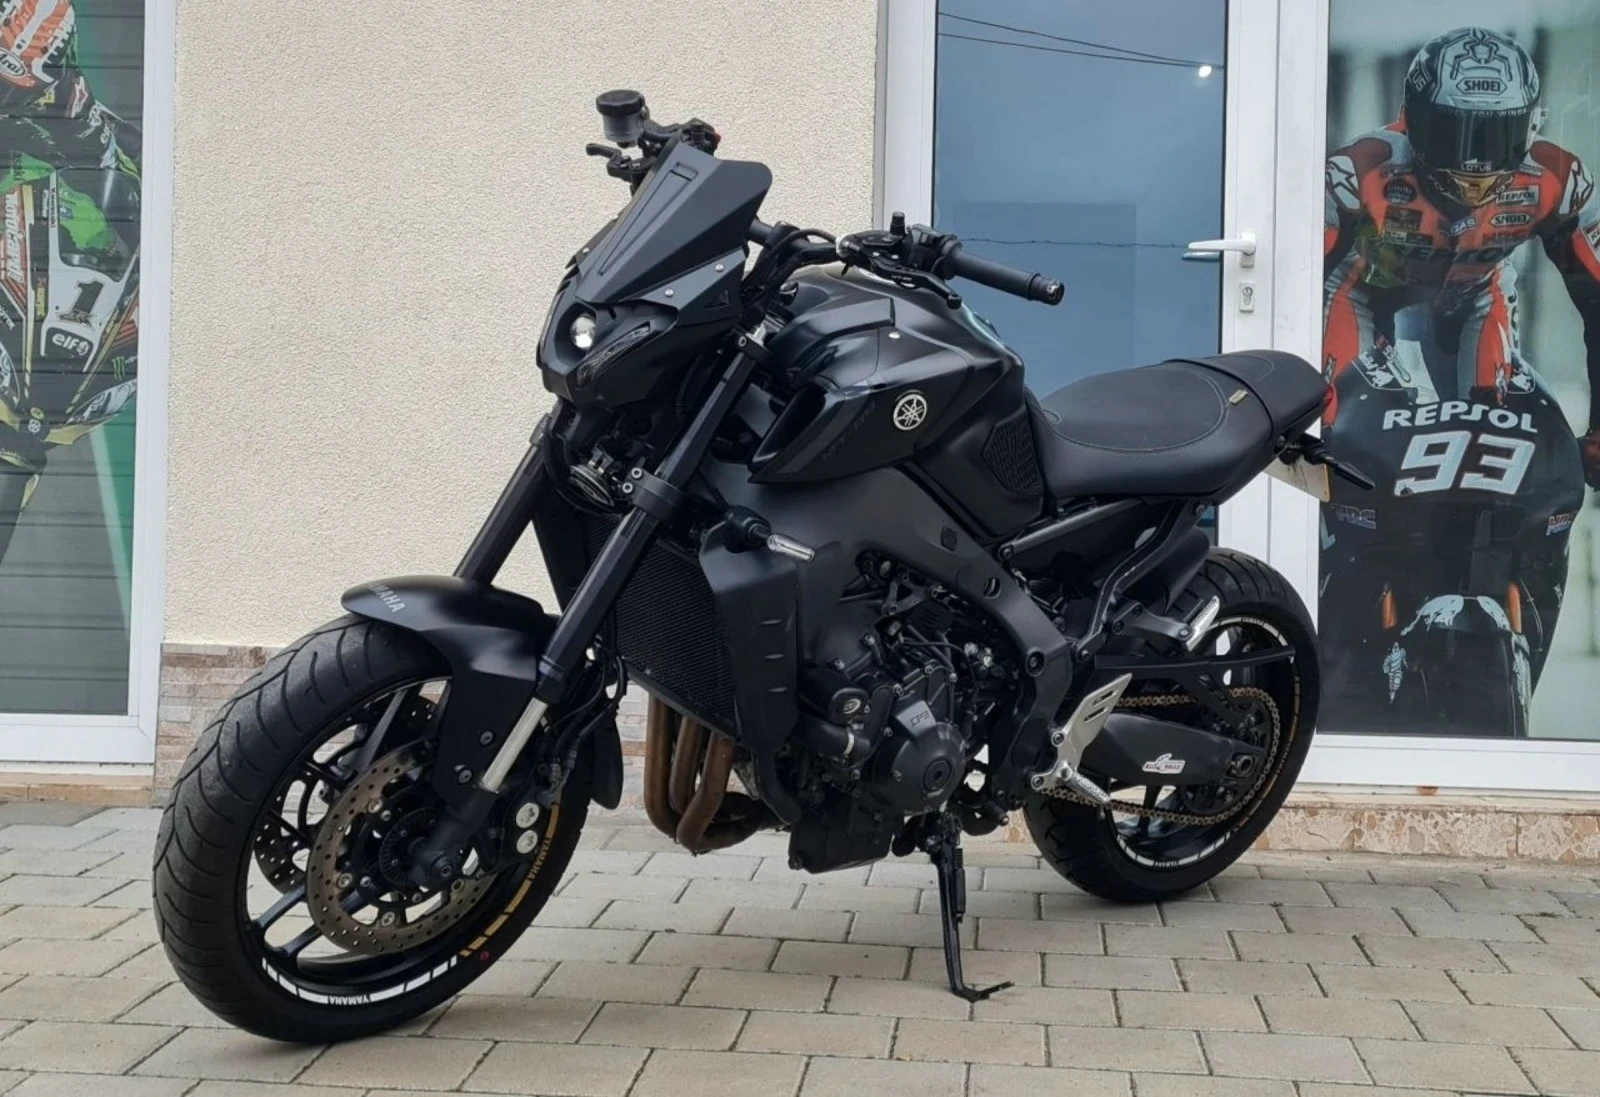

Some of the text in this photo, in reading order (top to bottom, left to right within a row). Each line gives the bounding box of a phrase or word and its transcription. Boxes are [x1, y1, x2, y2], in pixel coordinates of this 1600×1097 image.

[1463, 80, 1501, 92] SHOEI
[72, 280, 104, 314] 1
[52, 332, 80, 351] elf
[1382, 400, 1538, 433] REPSOL
[1394, 430, 1535, 497] 93
[329, 994, 369, 1006] YAMAHA
